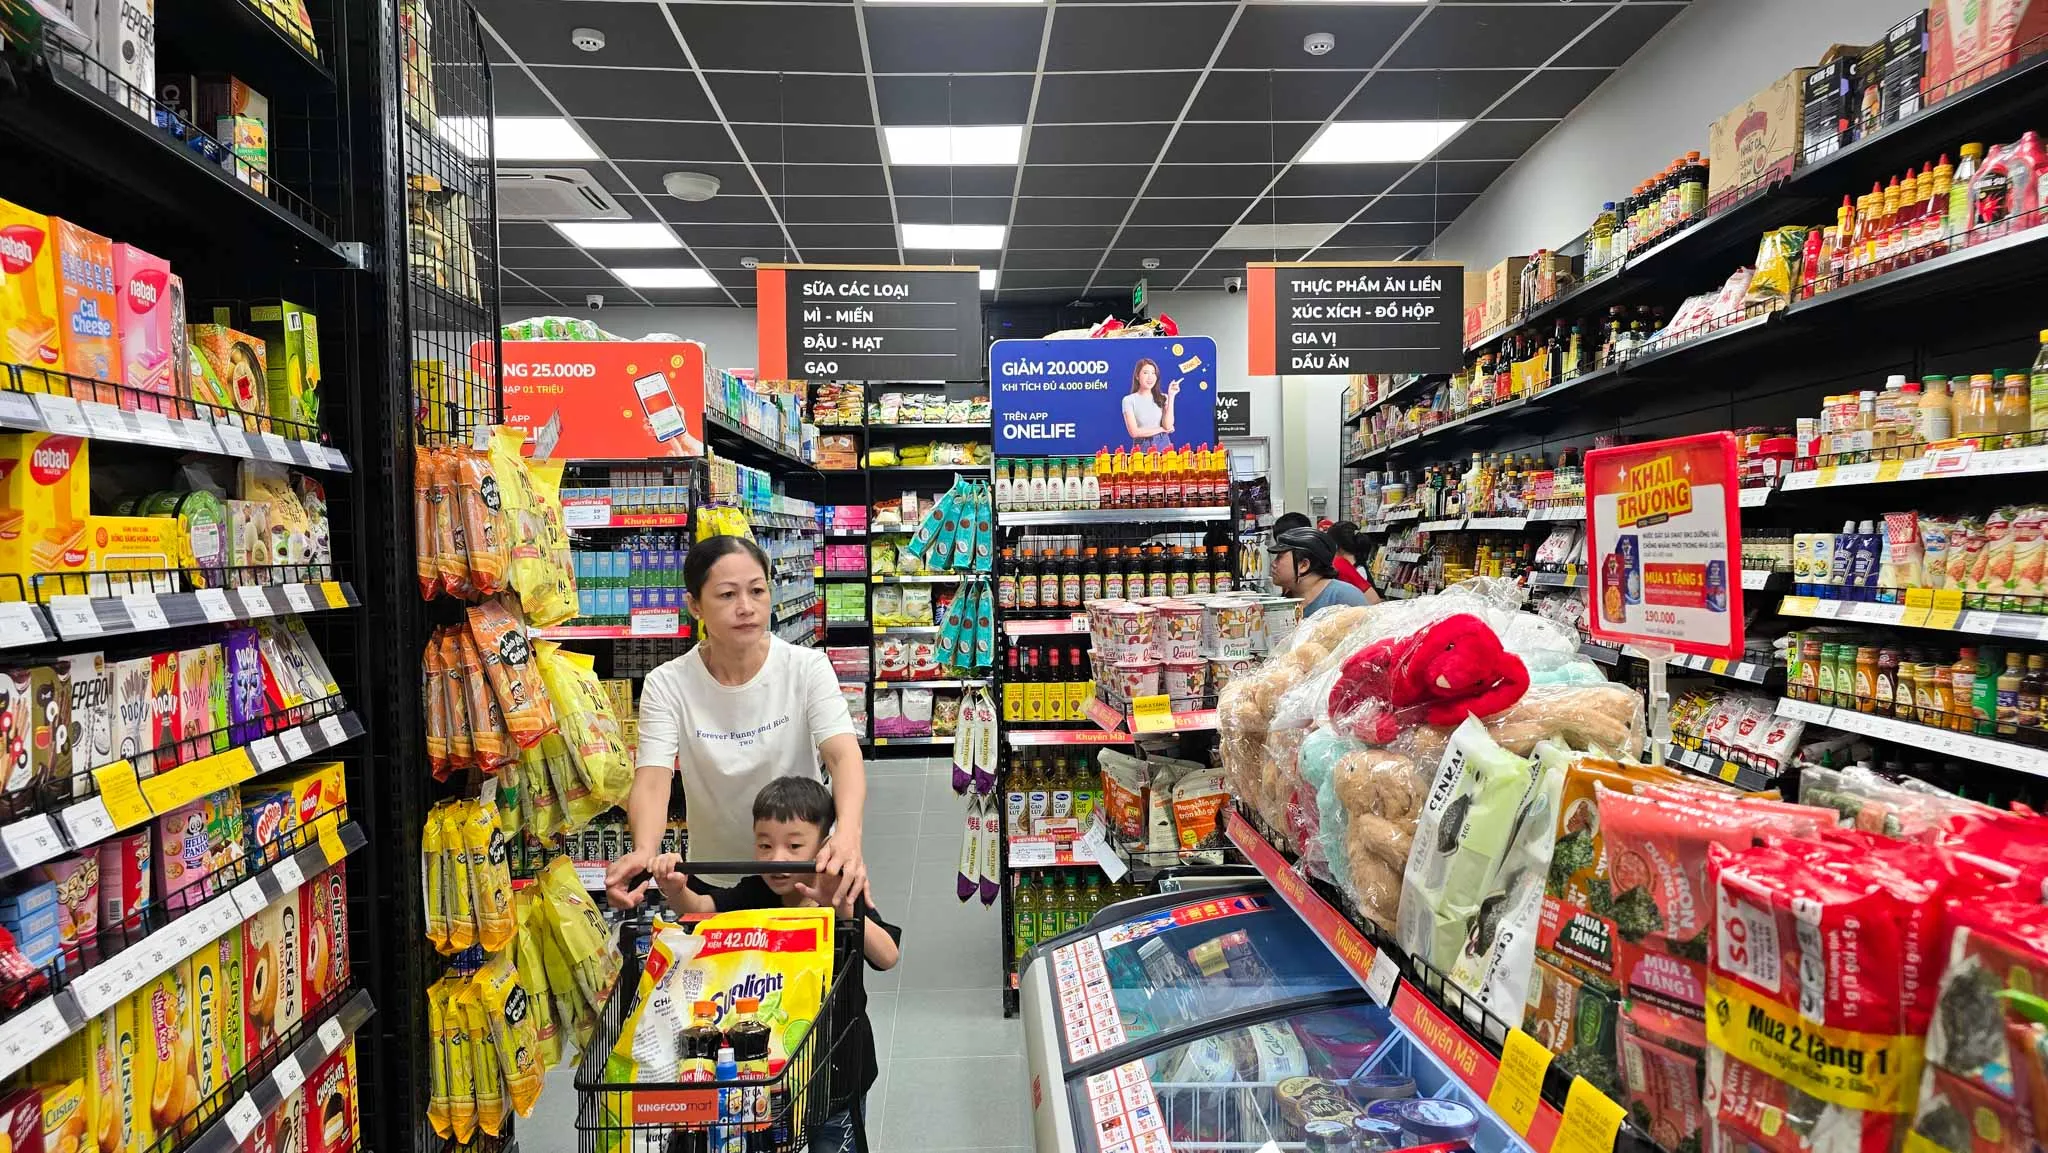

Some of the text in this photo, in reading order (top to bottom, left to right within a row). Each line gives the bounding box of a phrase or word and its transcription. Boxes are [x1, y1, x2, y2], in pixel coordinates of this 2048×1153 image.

[130, 280, 156, 304] nabati
[803, 281, 908, 300] SỮA CÁC LOẠI
[1291, 276, 1442, 294] THỰC PHẨM ĂN LIỀN
[80, 299, 98, 318] Cal
[804, 307, 820, 322] MÌ
[836, 306, 874, 323] MIẾN
[1292, 304, 1322, 318] XÚC
[1326, 304, 1361, 318] XÍCH
[1375, 300, 1399, 318] ĐỒ
[1402, 303, 1434, 320] HỘP
[72, 312, 111, 336] Cheese
[803, 333, 837, 352] ĐẬU
[852, 336, 884, 352] HẠT
[1292, 332, 1337, 346] GIA VỊ
[532, 363, 596, 378] 25.000Đ
[804, 362, 838, 376] GẠO
[1002, 358, 1108, 375] GIẢM 20.000Đ
[1292, 353, 1349, 369] DẦU ĂN
[536, 384, 564, 395] TRIỆU
[1002, 380, 1108, 392] KHI TÍCH ĐỦ 4.000 ĐIỂM
[1003, 411, 1048, 421] TRÊN APP
[1003, 424, 1076, 439] ONELIFE
[34, 448, 70, 470] nabati
[1632, 462, 1673, 490] KHAI
[1618, 482, 1690, 520] TRƯƠNG
[624, 516, 676, 526] Khuyến Mãi
[1646, 569, 1704, 588] MUA 1 TẶNG 1
[120, 700, 150, 724] POCKY
[152, 694, 178, 715] POCKY
[696, 714, 790, 740] Forever Funny and Rich
[1076, 732, 1126, 742] Khuyến Mãi
[1429, 750, 1463, 811] CENKAI
[186, 834, 208, 848] HELLO
[1574, 912, 1609, 937] MUA 2
[711, 930, 722, 939] TIẾT
[1570, 926, 1606, 953] TẶNG 1
[707, 941, 722, 950] KIỆM
[1336, 926, 1374, 975] Khuyến Mã
[282, 906, 296, 1018] Custas
[1644, 954, 1692, 980] MUA 2
[1643, 971, 1694, 999] TẶNG 1
[710, 972, 784, 1025] Sunlight
[198, 964, 214, 1098] Custas
[1748, 1004, 1888, 1076] Mua 2 tặng 1
[1414, 1005, 1451, 1055] Khuyến
[1452, 1043, 1478, 1078] Mãi
[317, 1062, 345, 1107] CHOCOLATE
[1834, 1076, 1844, 1090] 2
[45, 1095, 80, 1128] Custas
[1512, 1097, 1524, 1114] 32
